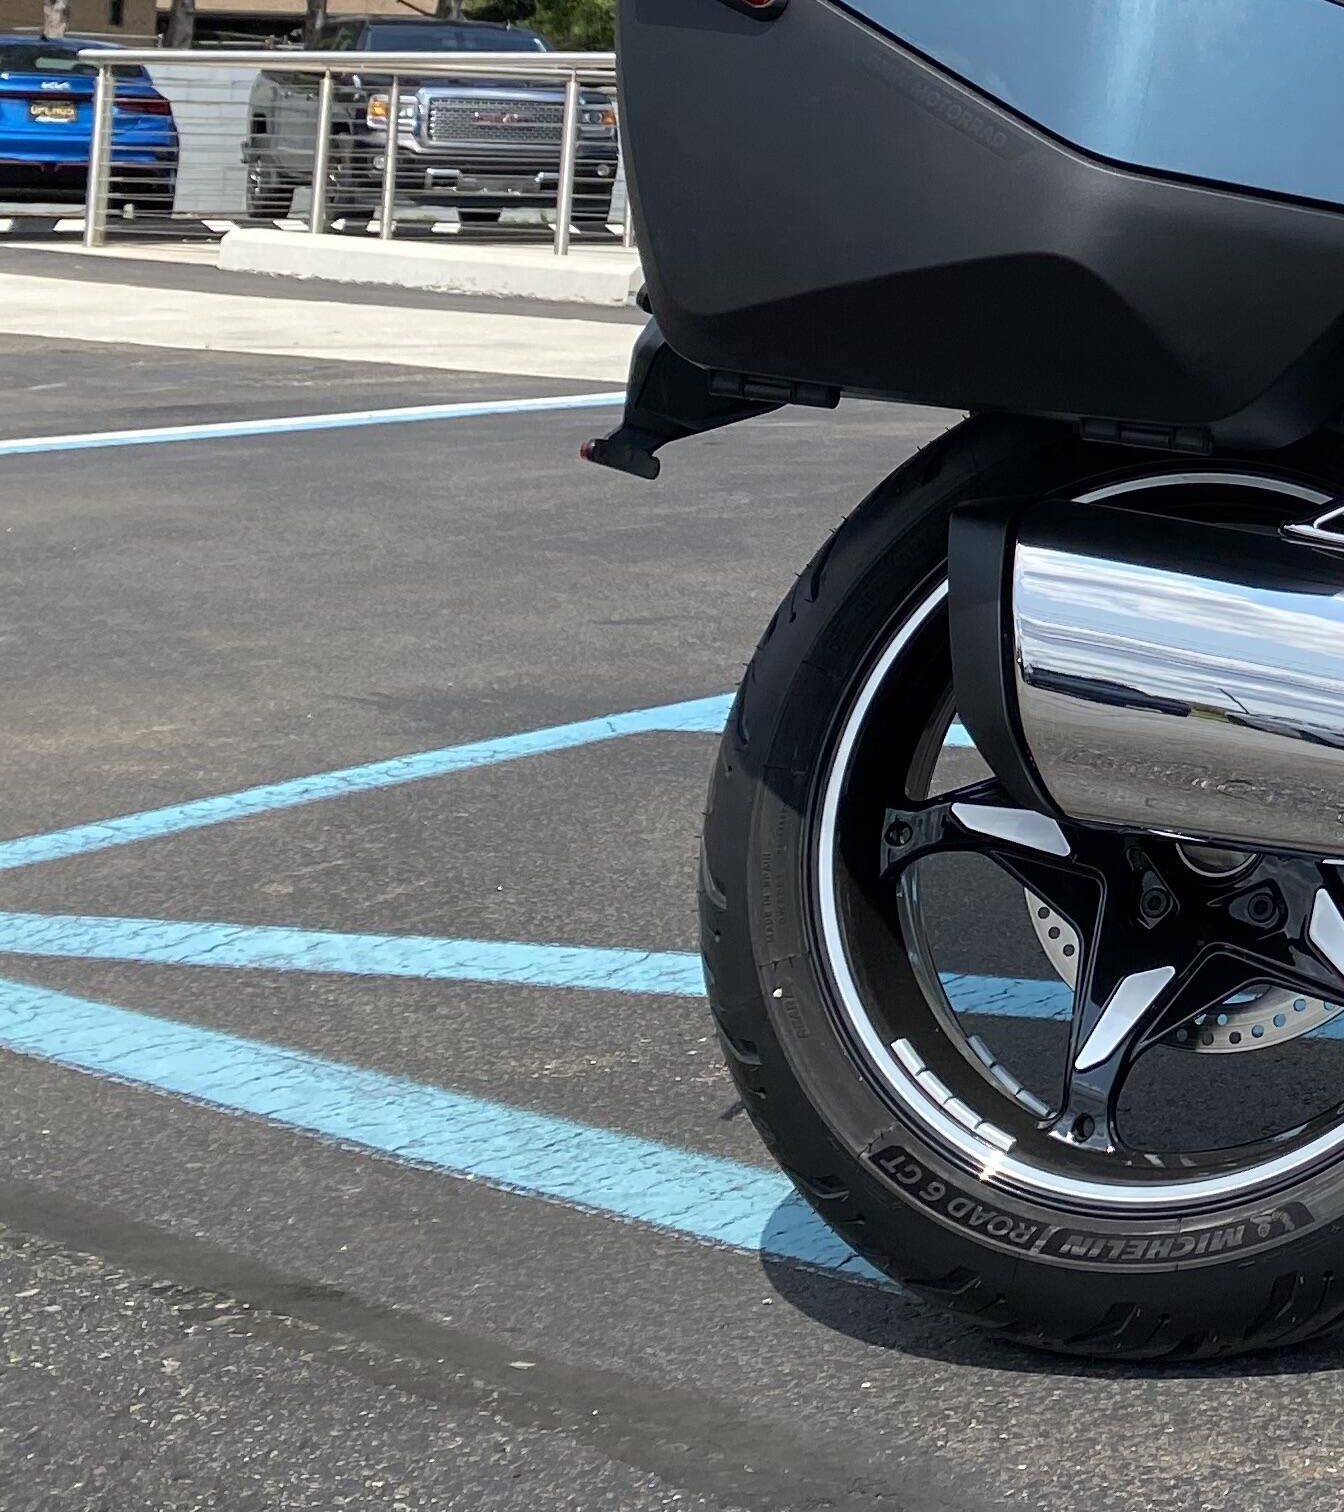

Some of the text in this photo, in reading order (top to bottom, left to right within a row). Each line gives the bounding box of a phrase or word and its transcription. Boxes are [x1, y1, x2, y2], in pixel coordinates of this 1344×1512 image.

[880, 1153, 1244, 1261] MICHELIN ROAD 6 GT
